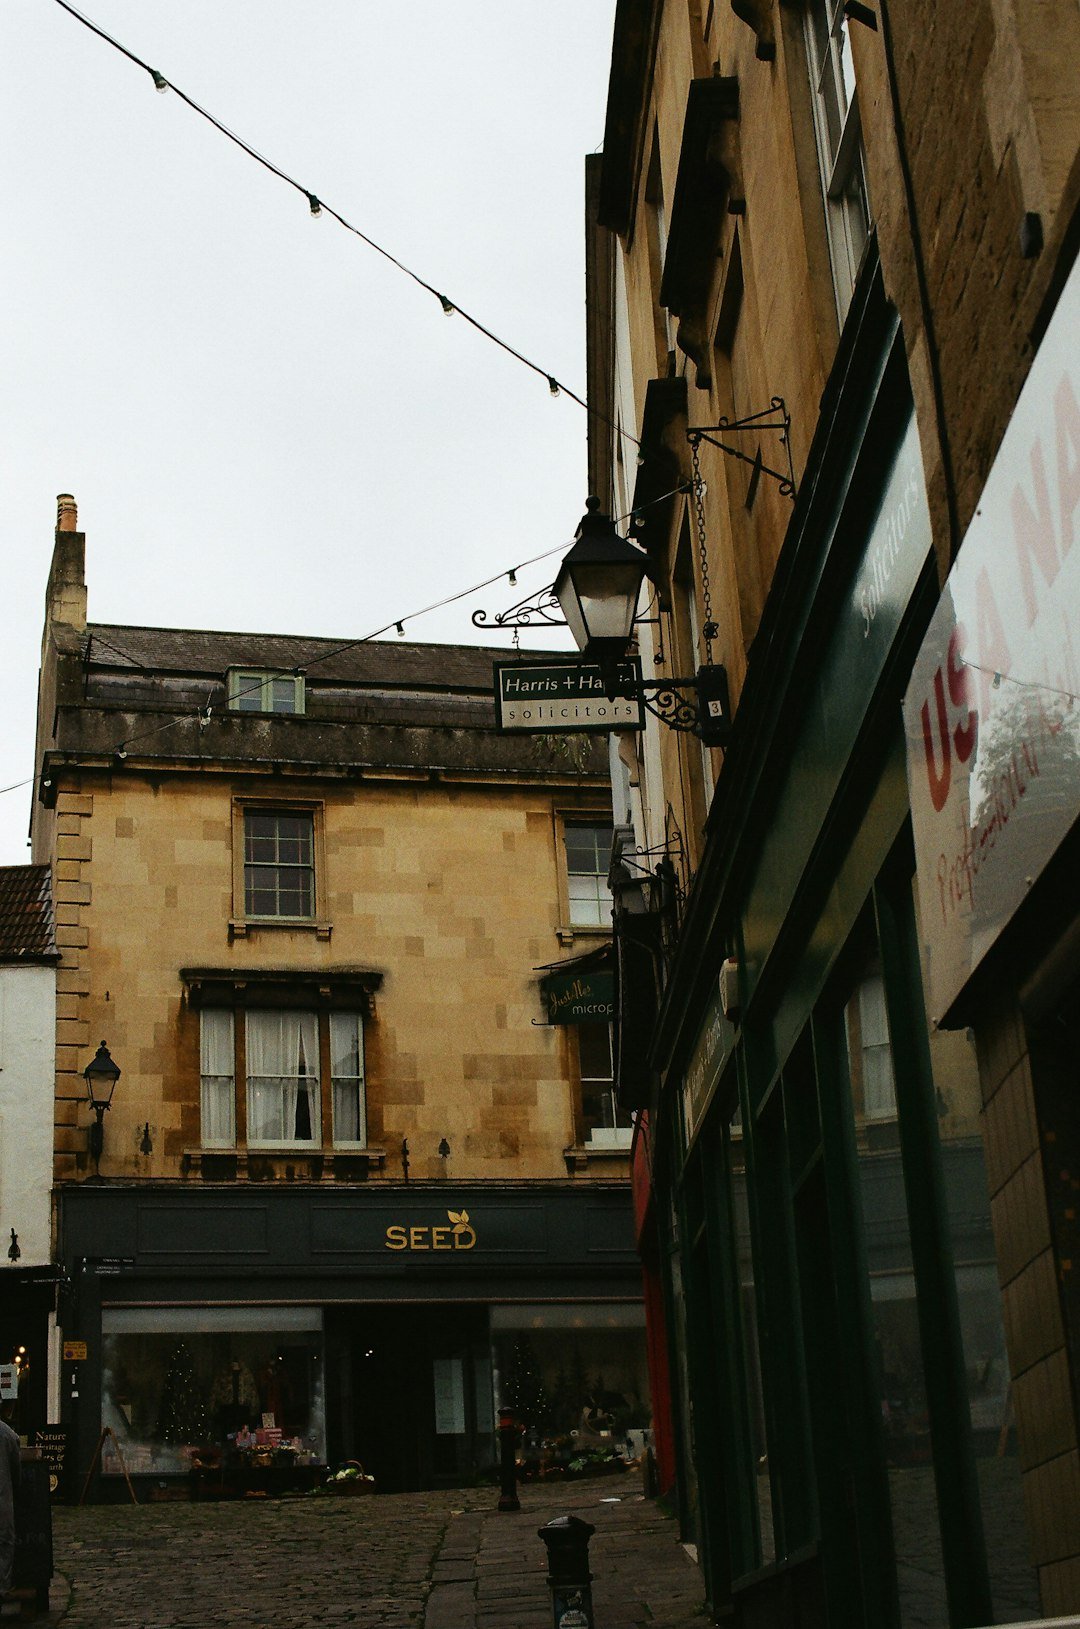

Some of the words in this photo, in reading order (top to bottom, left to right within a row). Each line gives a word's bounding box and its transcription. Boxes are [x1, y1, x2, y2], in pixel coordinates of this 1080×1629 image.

[505, 677, 559, 692] Harris
[509, 705, 632, 720] solicitors
[711, 702, 719, 714] 3
[384, 1224, 477, 1250] SEED
[35, 1431, 66, 1441] Nature
